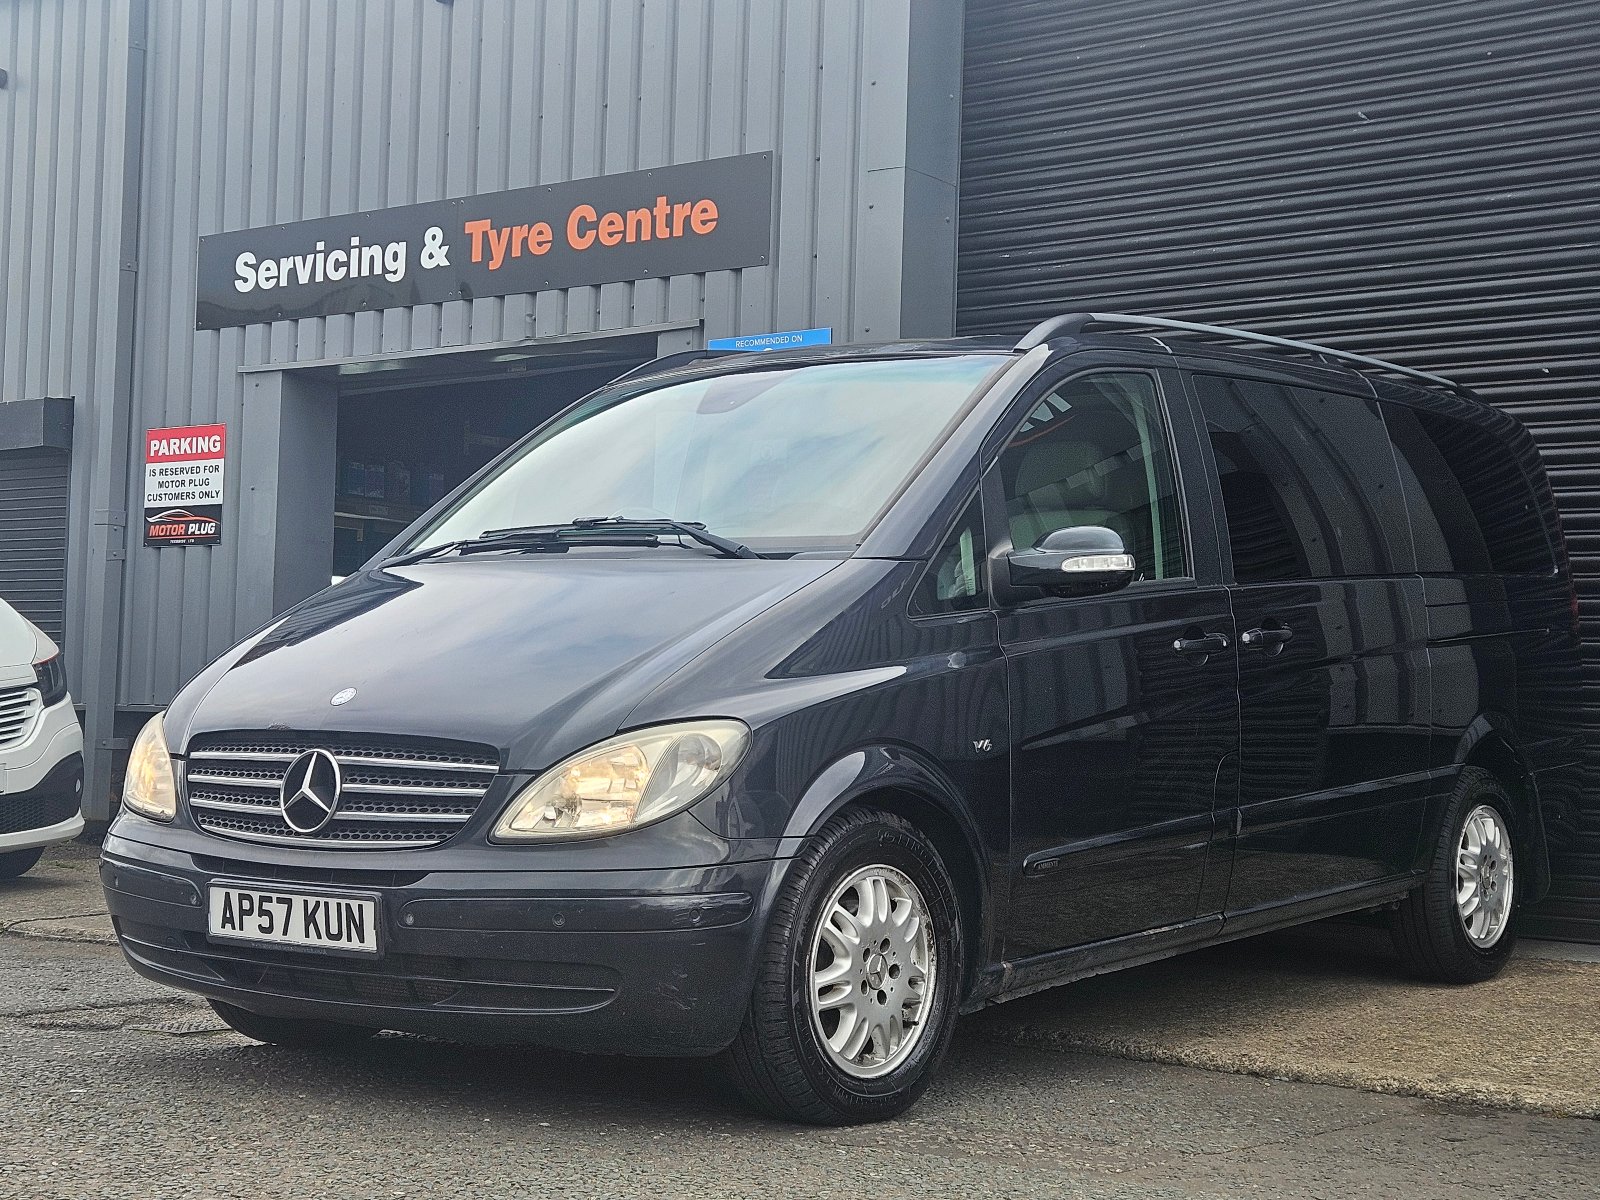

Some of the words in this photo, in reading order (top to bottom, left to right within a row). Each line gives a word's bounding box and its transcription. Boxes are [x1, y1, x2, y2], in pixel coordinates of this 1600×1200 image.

[234, 236, 407, 293] Servicing
[420, 226, 450, 269] &
[464, 218, 553, 270] Tyre
[566, 195, 719, 251] Centre
[735, 336, 790, 348] RECOMMENDED
[791, 334, 803, 343] ON
[150, 435, 221, 456] PARKING
[149, 468, 157, 477] IS
[159, 465, 201, 477] RESERVED
[203, 465, 220, 473] FOR
[158, 480, 186, 489] MOTOR
[188, 478, 210, 487] PLUG
[147, 492, 196, 502] CUSTOMERS
[198, 490, 221, 500] ONLY
[149, 524, 186, 536] MOTOR
[187, 523, 216, 535] PLUG
[973, 739, 993, 753] V6
[220, 891, 293, 937] AP57
[302, 899, 365, 944] KUN
